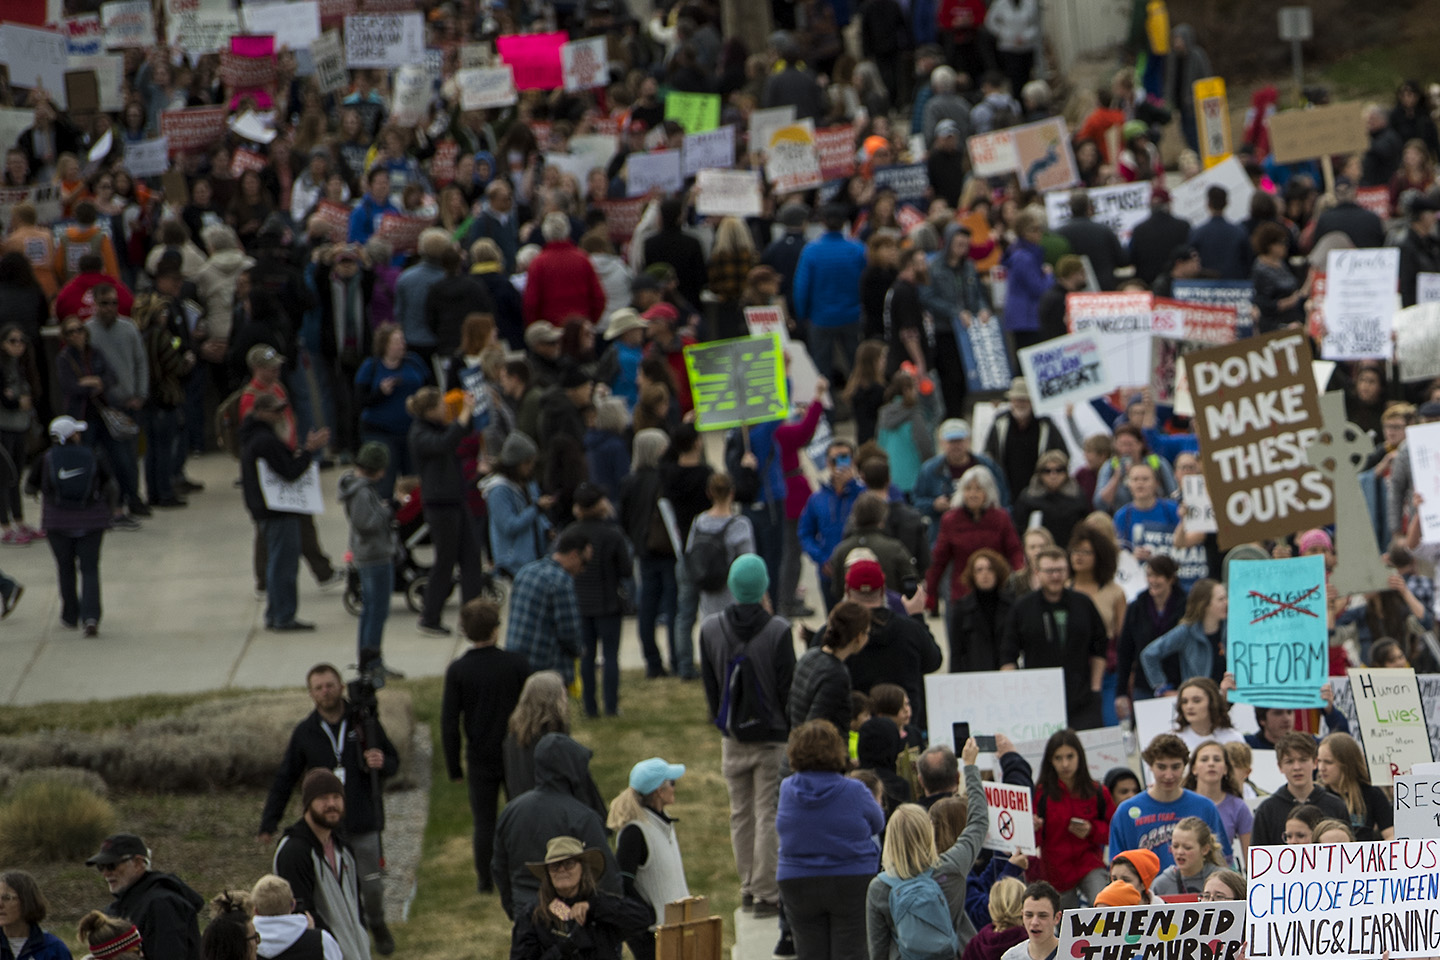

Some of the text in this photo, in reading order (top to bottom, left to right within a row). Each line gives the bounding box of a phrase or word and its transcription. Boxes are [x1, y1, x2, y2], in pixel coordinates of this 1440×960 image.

[1192, 334, 1303, 396] DON'T
[1204, 384, 1309, 440] MAKE
[1211, 428, 1319, 483] THESE
[1226, 471, 1333, 526] OURS
[1232, 640, 1326, 686] REFORM
[1359, 673, 1411, 698] Human
[1372, 700, 1420, 724] Lives
[1250, 840, 1438, 880] DON'T MAKE US
[1249, 872, 1440, 919] CHOOSE BETWEEN
[1070, 908, 1176, 939] WHEN
